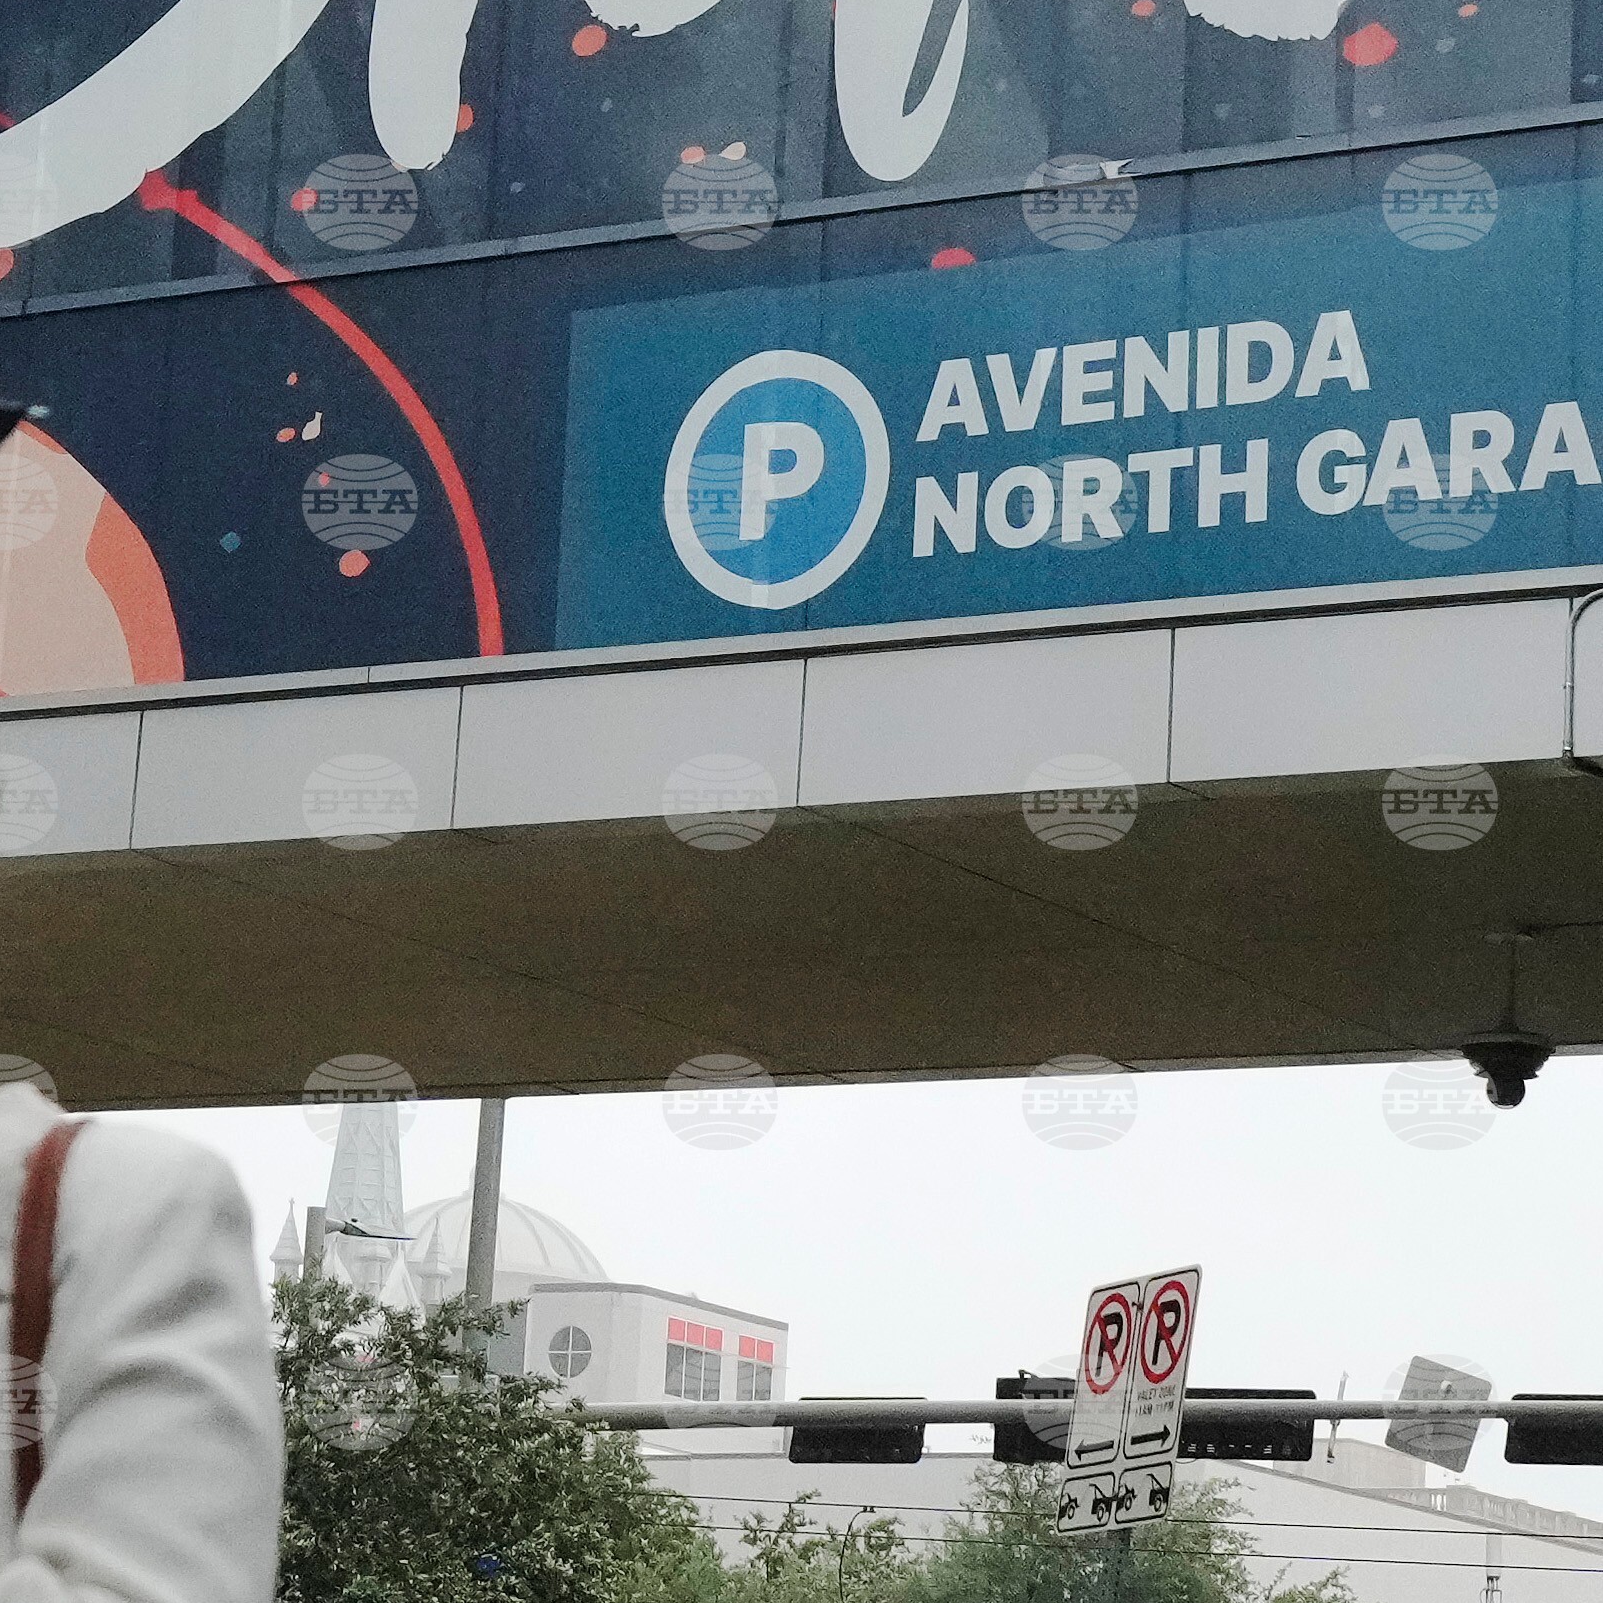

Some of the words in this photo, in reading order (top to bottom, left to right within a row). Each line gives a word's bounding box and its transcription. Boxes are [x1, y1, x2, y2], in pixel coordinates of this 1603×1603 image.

[915, 309, 1372, 442] AVENIDA
[911, 443, 1270, 559] NORTH
[1295, 399, 1603, 517] GARA
